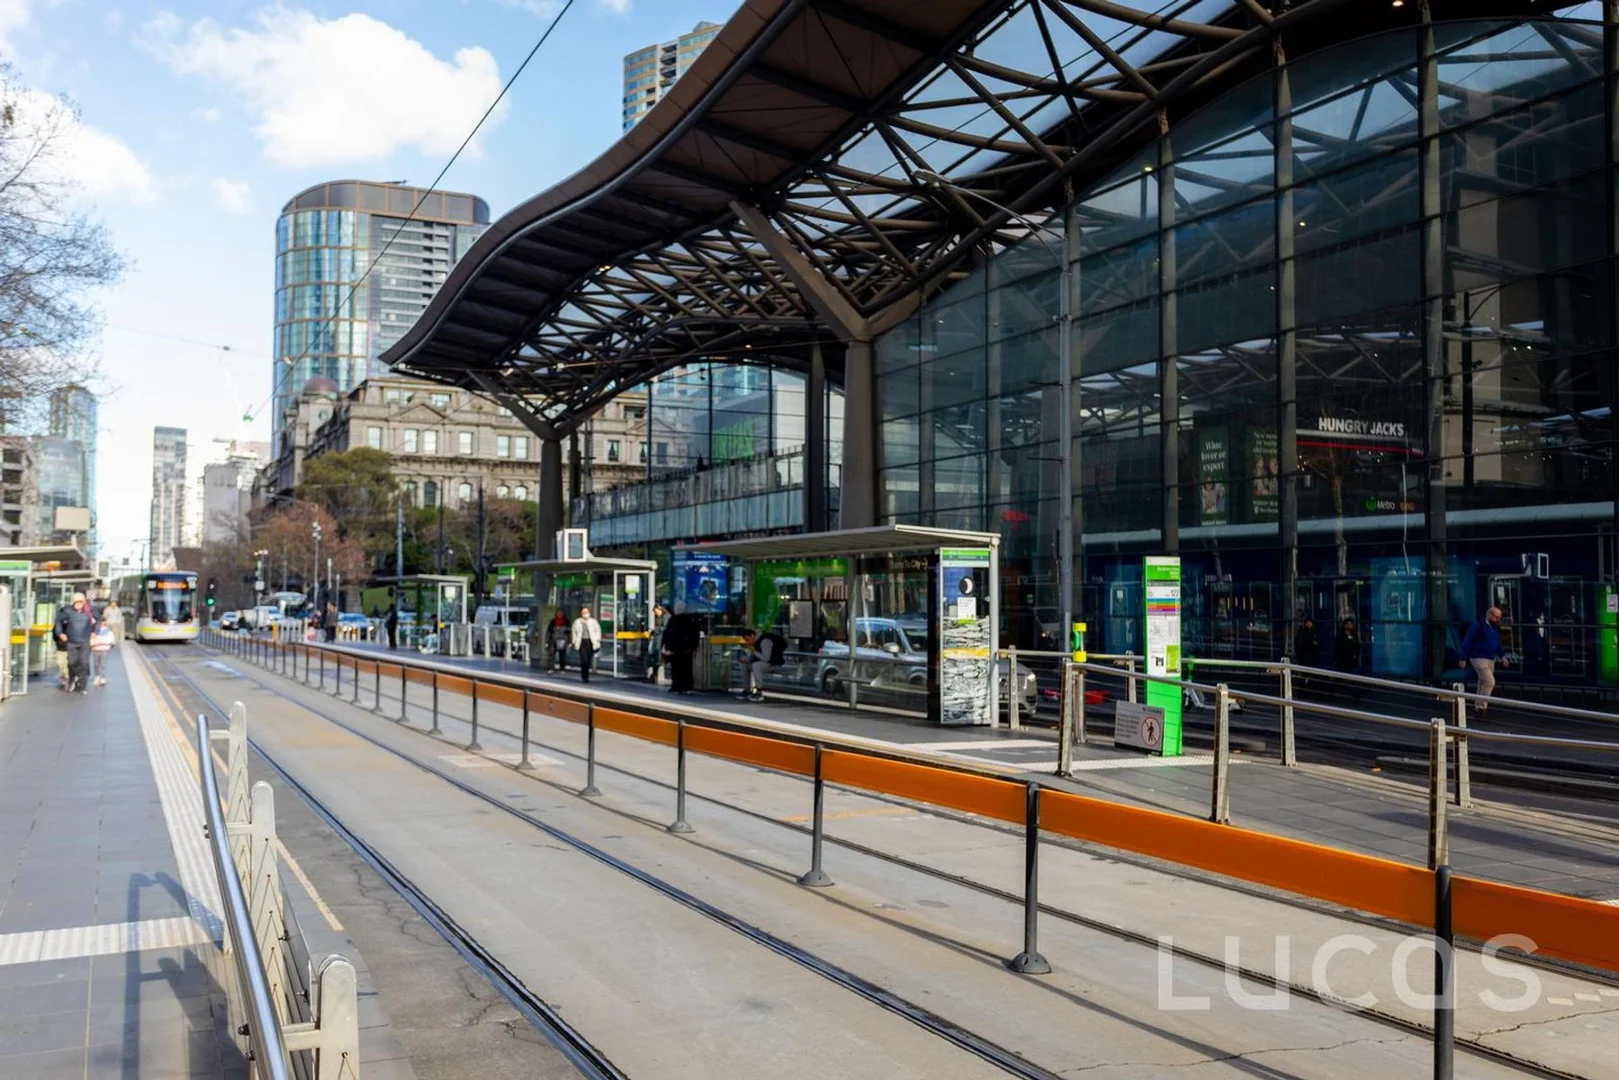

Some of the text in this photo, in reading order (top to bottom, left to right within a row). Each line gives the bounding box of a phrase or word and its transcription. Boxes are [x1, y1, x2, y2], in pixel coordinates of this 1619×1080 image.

[1318, 416, 1369, 434] HUNGRY
[1205, 440, 1222, 450] Wine
[1201, 451, 1227, 461] lover or
[1203, 461, 1225, 473] expert
[1377, 499, 1396, 511] Metro
